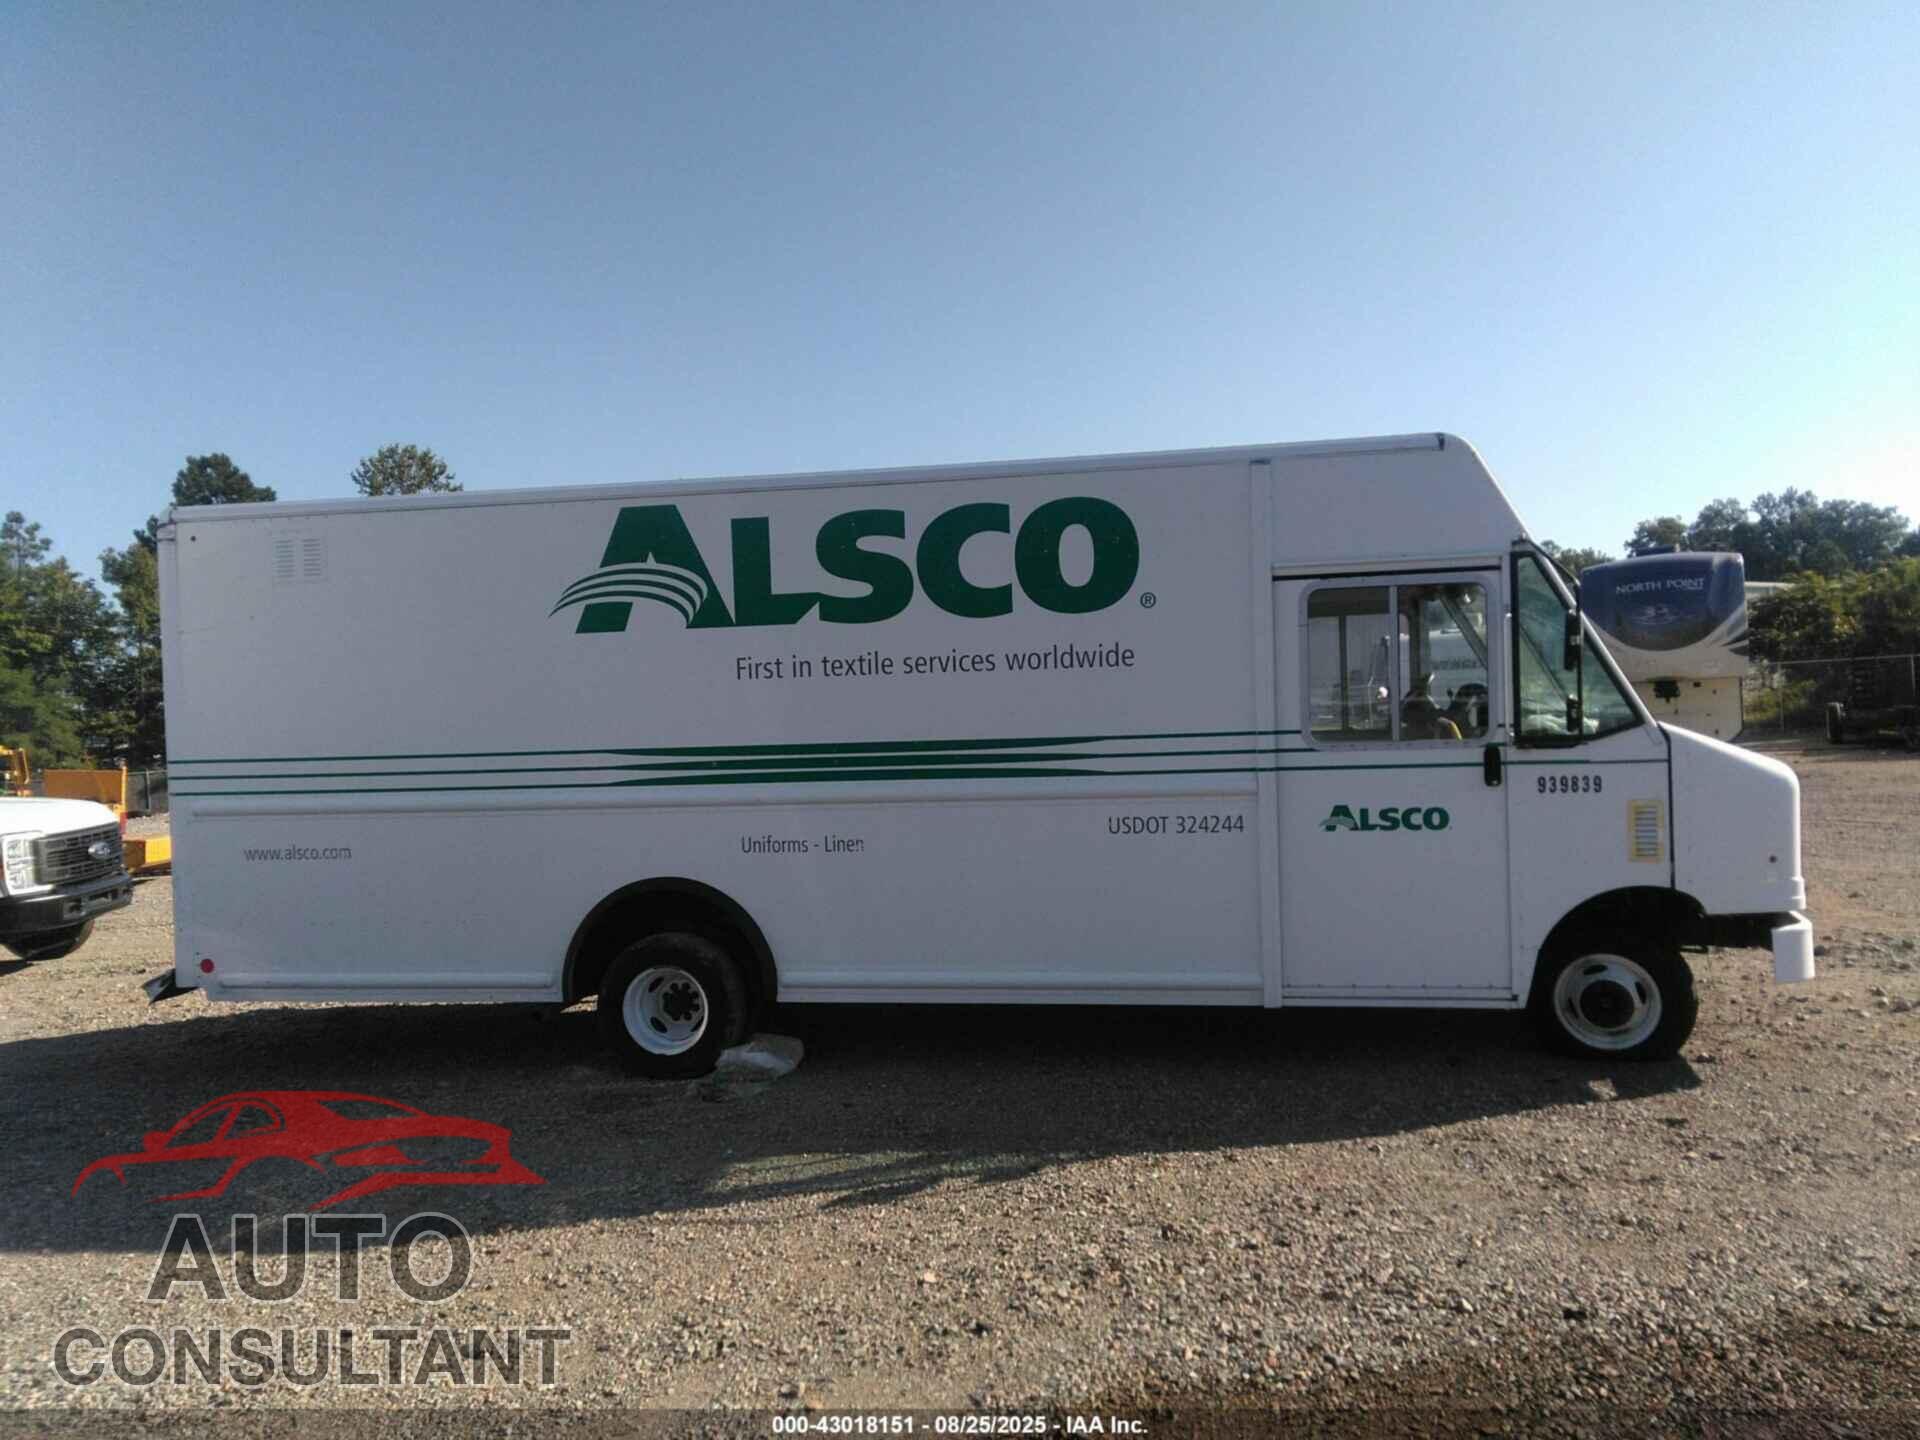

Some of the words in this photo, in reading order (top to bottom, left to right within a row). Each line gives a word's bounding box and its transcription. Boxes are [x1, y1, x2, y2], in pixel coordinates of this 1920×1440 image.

[549, 496, 1140, 634] ALSCO
[1615, 581, 1662, 594] NORTH
[1666, 577, 1705, 590] POINT
[736, 656, 784, 680] First
[792, 654, 812, 678] in
[821, 651, 894, 677] textile
[903, 648, 996, 674] services
[1005, 642, 1135, 671] worldwide
[1537, 775, 1603, 794] 939839
[1108, 815, 1169, 834] USDOT
[1176, 814, 1244, 834] 324244
[1320, 804, 1451, 832] ALSCO
[243, 843, 352, 861] www.alsco.com
[741, 834, 808, 853] Uniforms
[824, 834, 865, 853] Linen
